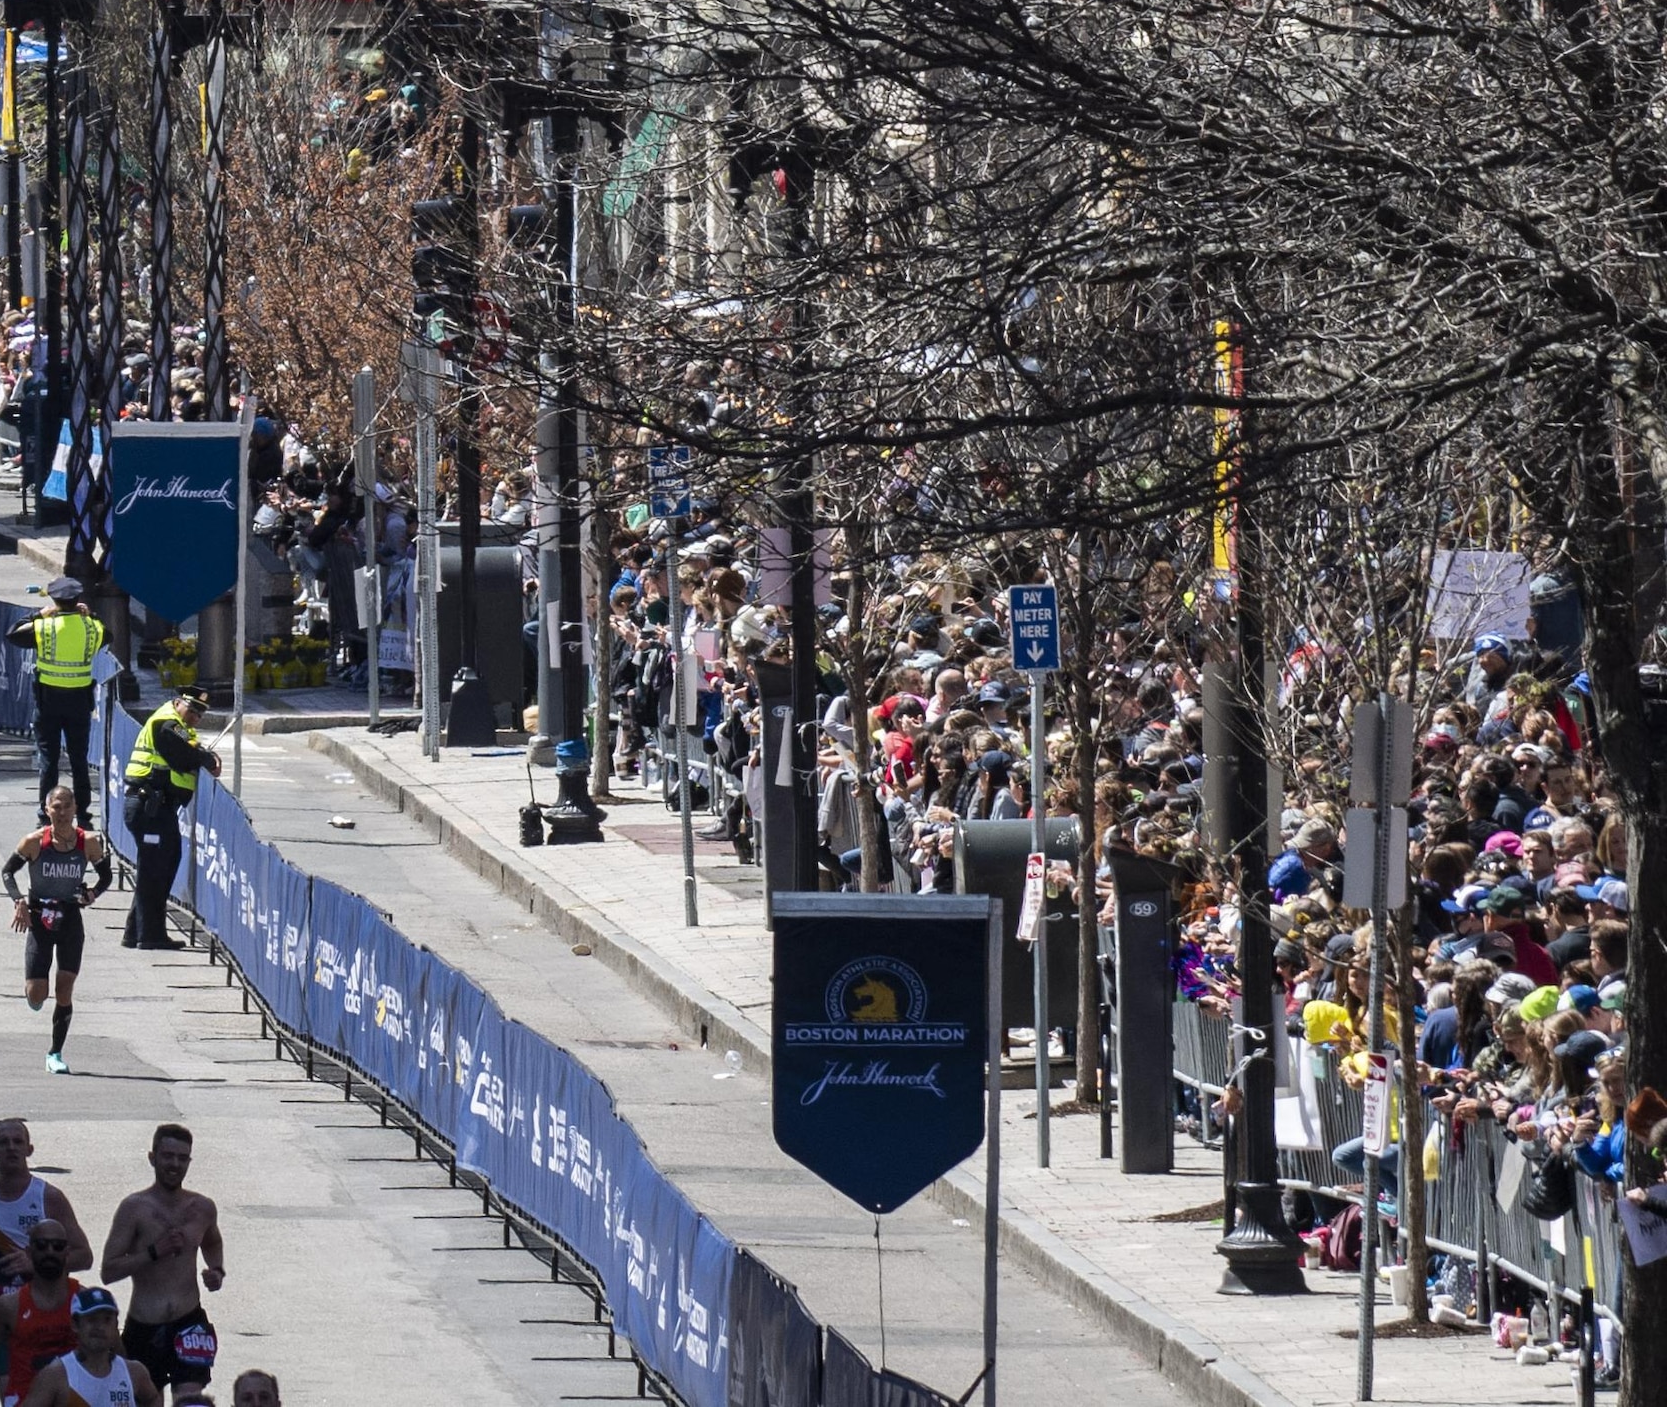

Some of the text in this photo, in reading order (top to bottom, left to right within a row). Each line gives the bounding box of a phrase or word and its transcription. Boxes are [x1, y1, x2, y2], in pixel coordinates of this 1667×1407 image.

[115, 475, 236, 515] John Hancock
[1022, 591, 1042, 604] PAY
[1014, 610, 1053, 623] METER
[1020, 626, 1050, 639] HERE
[42, 862, 81, 879] CANADA
[1134, 903, 1152, 915] 59
[785, 1027, 965, 1041] BOSTON MARATHON
[800, 1059, 947, 1107] John Hancock
[18, 1215, 39, 1226] BOS
[183, 1333, 214, 1350] 6040
[110, 1391, 130, 1402] BOS
